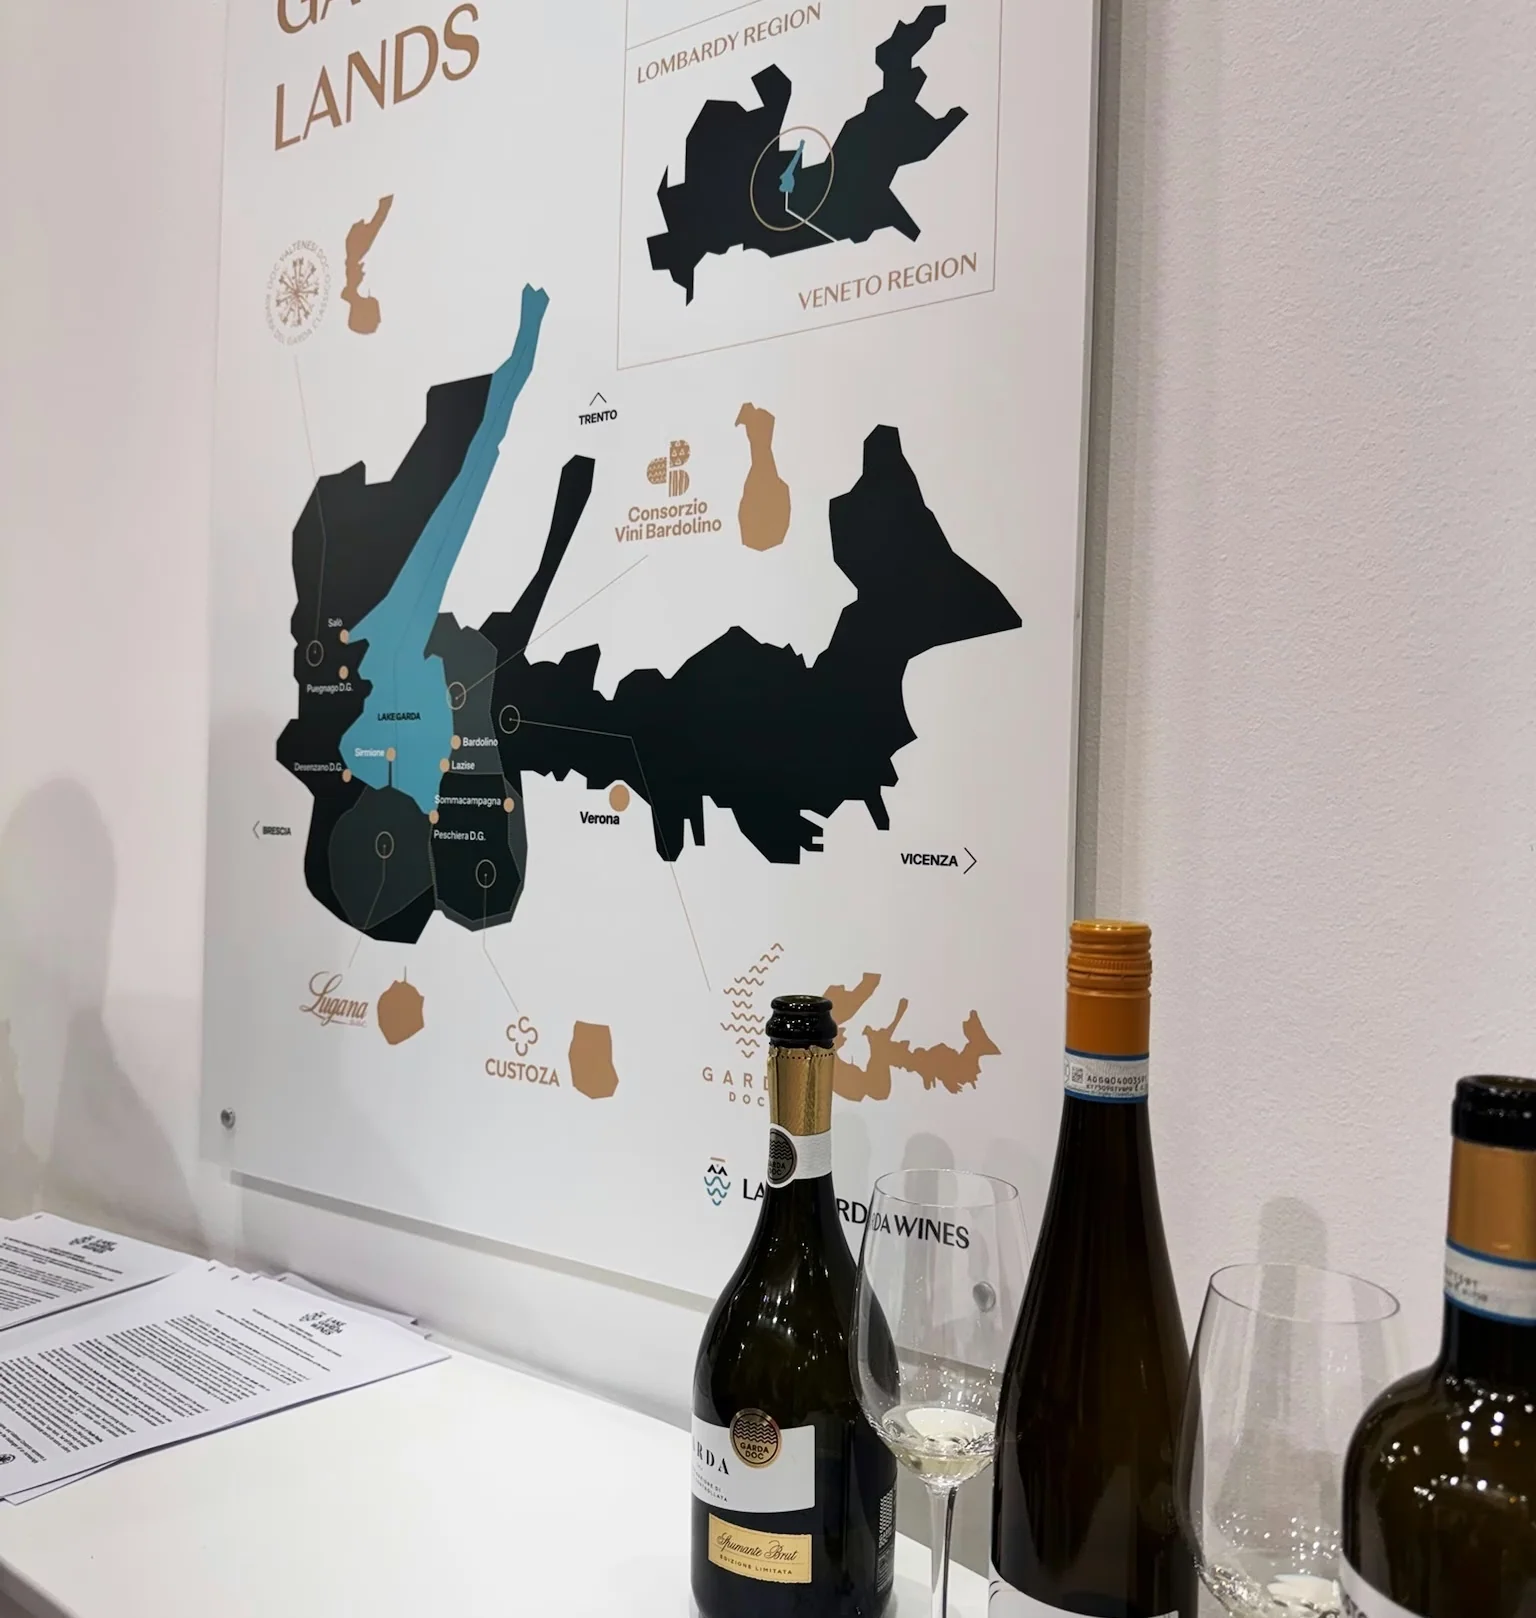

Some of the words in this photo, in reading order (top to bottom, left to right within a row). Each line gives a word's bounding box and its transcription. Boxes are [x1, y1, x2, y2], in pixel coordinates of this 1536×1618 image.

[637, 31, 739, 84] LOMBARDY
[744, 2, 821, 46] REGION
[275, 3, 480, 150] LANDS
[798, 274, 882, 311] VENETO
[888, 252, 977, 291] REGION
[578, 409, 618, 426] TRENTO
[628, 498, 708, 524] Consorzio
[614, 525, 643, 543] Vini
[646, 516, 722, 540] Bardolino
[328, 618, 343, 628] Salò
[306, 684, 339, 694] Puegnago
[377, 712, 395, 721] LAKE
[396, 712, 421, 721] GARDA
[462, 737, 498, 747] Bardolino
[354, 748, 385, 758] Sirmione
[294, 762, 329, 772] Desenzano
[451, 760, 475, 770] Lazise
[434, 795, 502, 807] Sommacampagna
[579, 811, 621, 826] Verona
[262, 826, 292, 836] BRESCIA
[434, 829, 469, 840] Peschiera
[470, 830, 486, 841] D.G.
[900, 852, 959, 868] VICENZA
[299, 971, 369, 1027] Lugana
[485, 1058, 560, 1087] CUSTOZA
[729, 1091, 765, 1107] DOC
[894, 1215, 971, 1249] WINES
[740, 1442, 769, 1453] GARDA
[745, 1450, 764, 1460] DOC
[717, 1532, 762, 1557] Spumante
[764, 1540, 798, 1561] Brut
[720, 1555, 752, 1570] EDIZIONE
[755, 1566, 793, 1575] LIMITATA
